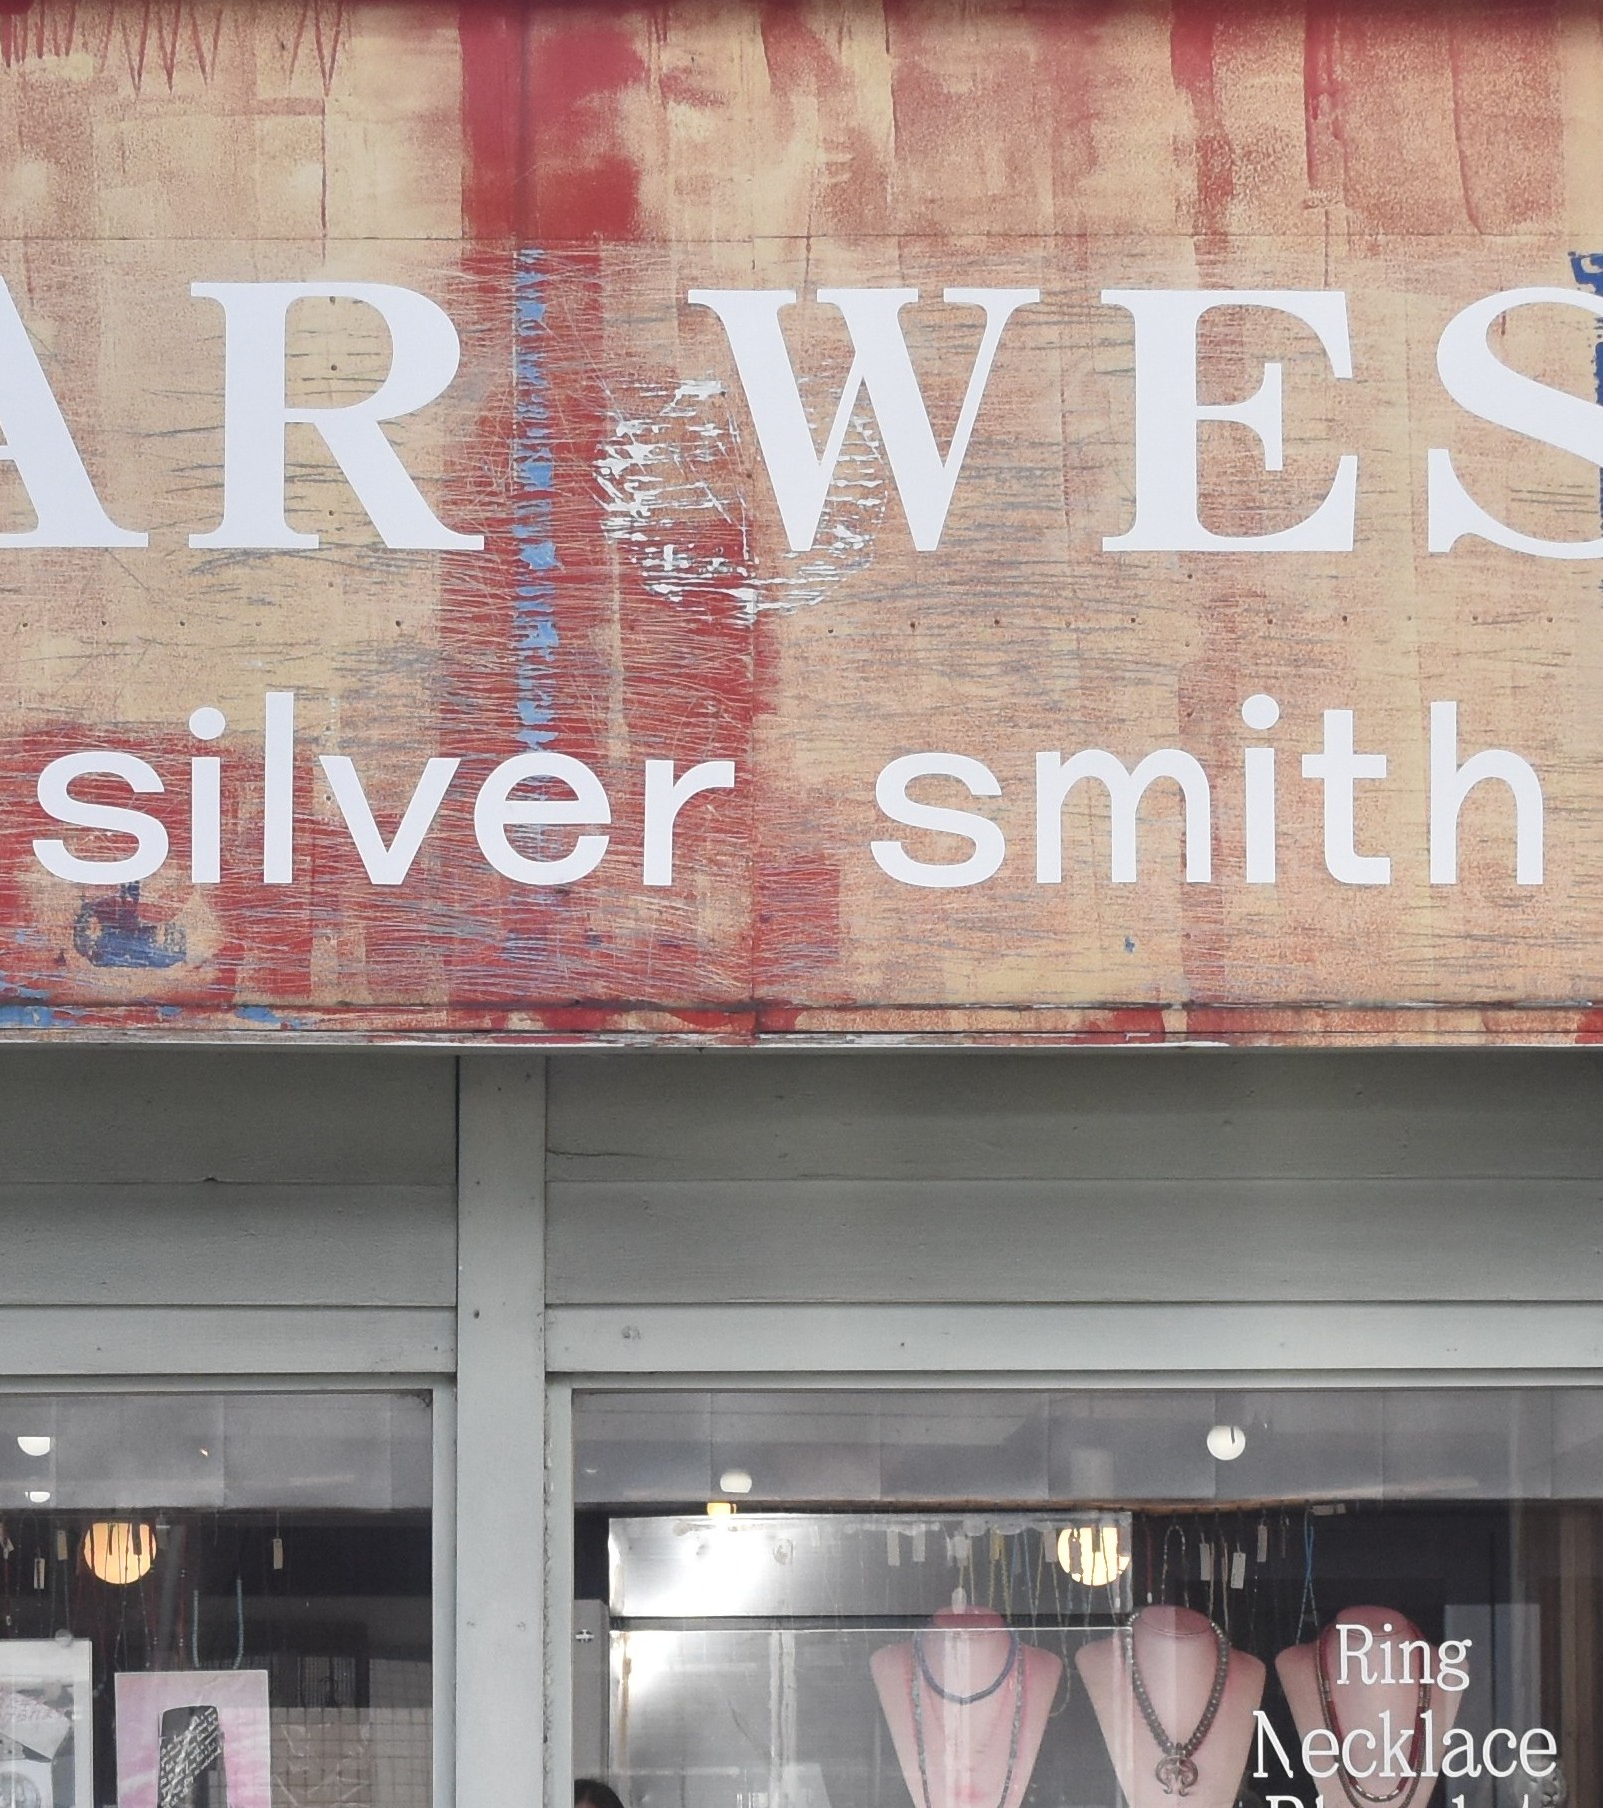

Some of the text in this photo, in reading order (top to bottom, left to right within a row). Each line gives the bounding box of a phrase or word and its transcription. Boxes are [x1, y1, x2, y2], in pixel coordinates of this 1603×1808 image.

[32, 691, 1545, 887] silver smith
[1335, 1624, 1473, 1692] Ring
[1252, 1709, 1557, 1779] Necklace
